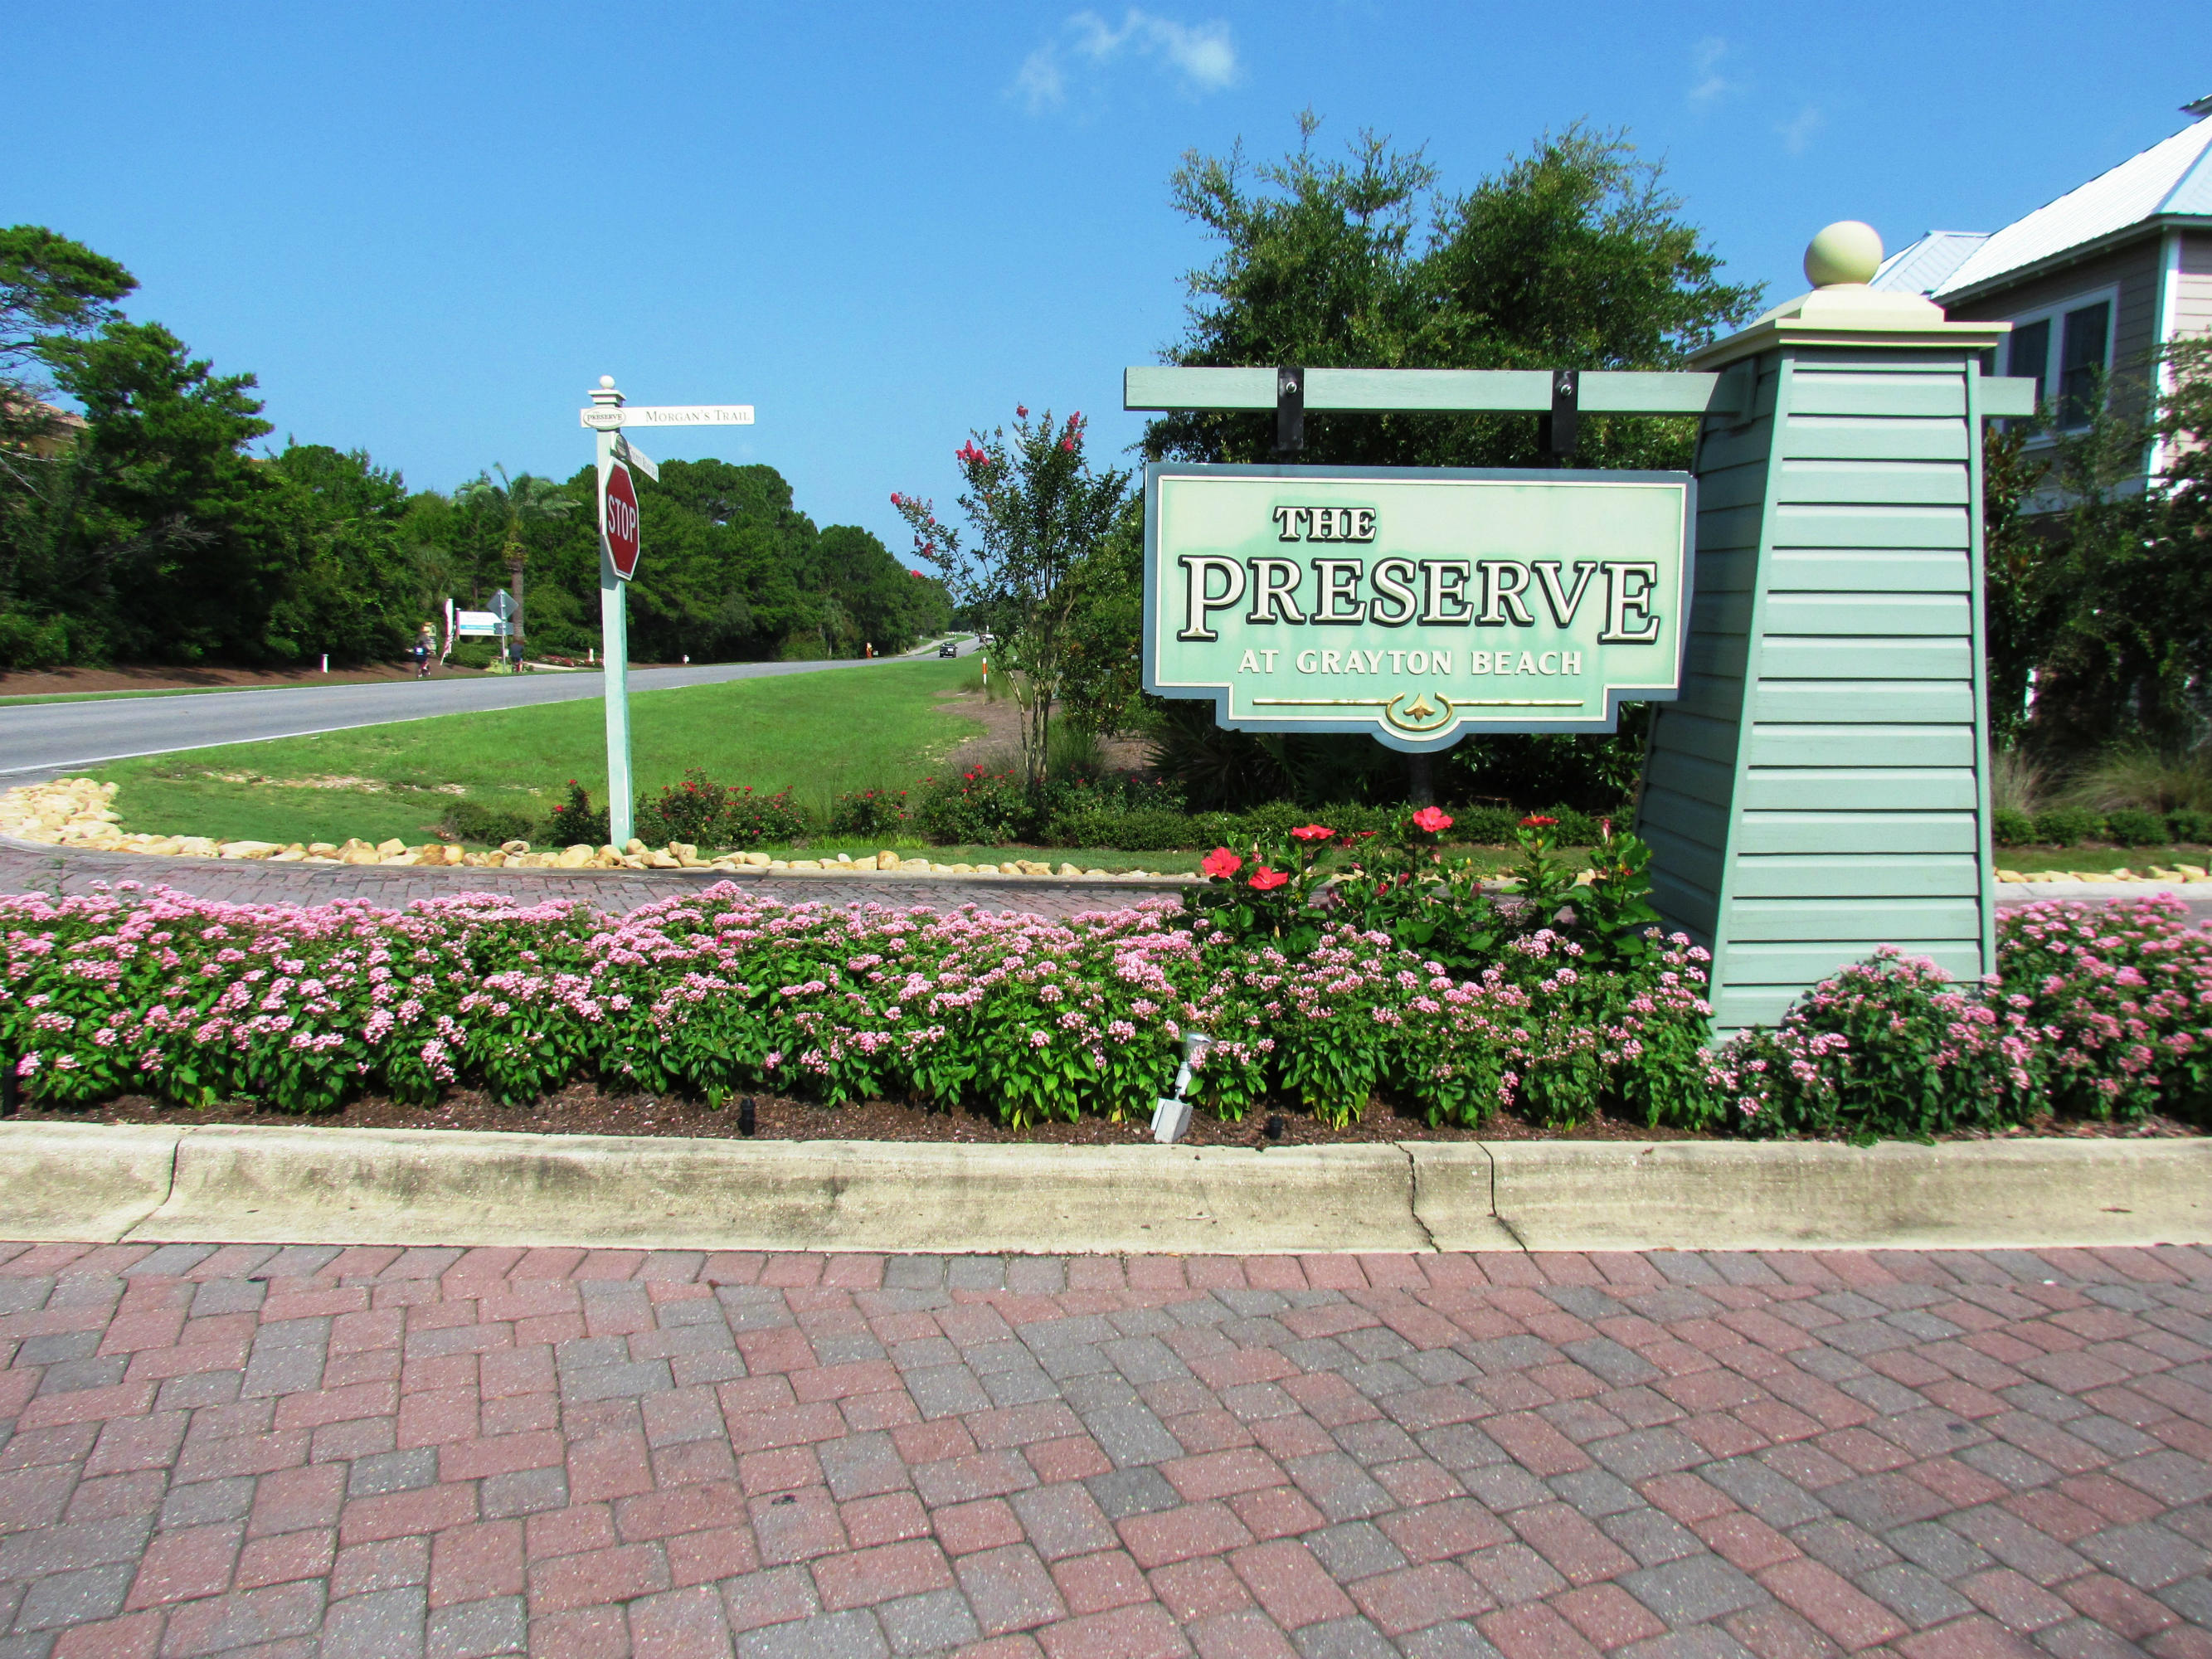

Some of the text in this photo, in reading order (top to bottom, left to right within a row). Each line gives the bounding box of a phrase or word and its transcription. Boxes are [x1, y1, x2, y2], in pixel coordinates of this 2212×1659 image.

[645, 409, 751, 422] MORGAN'S TRAIL
[607, 494, 636, 543] STOP
[1272, 505, 1377, 542] THE
[1176, 554, 1660, 645] PRESERVE
[1238, 649, 1582, 676] AT GRAYTON BEACH
